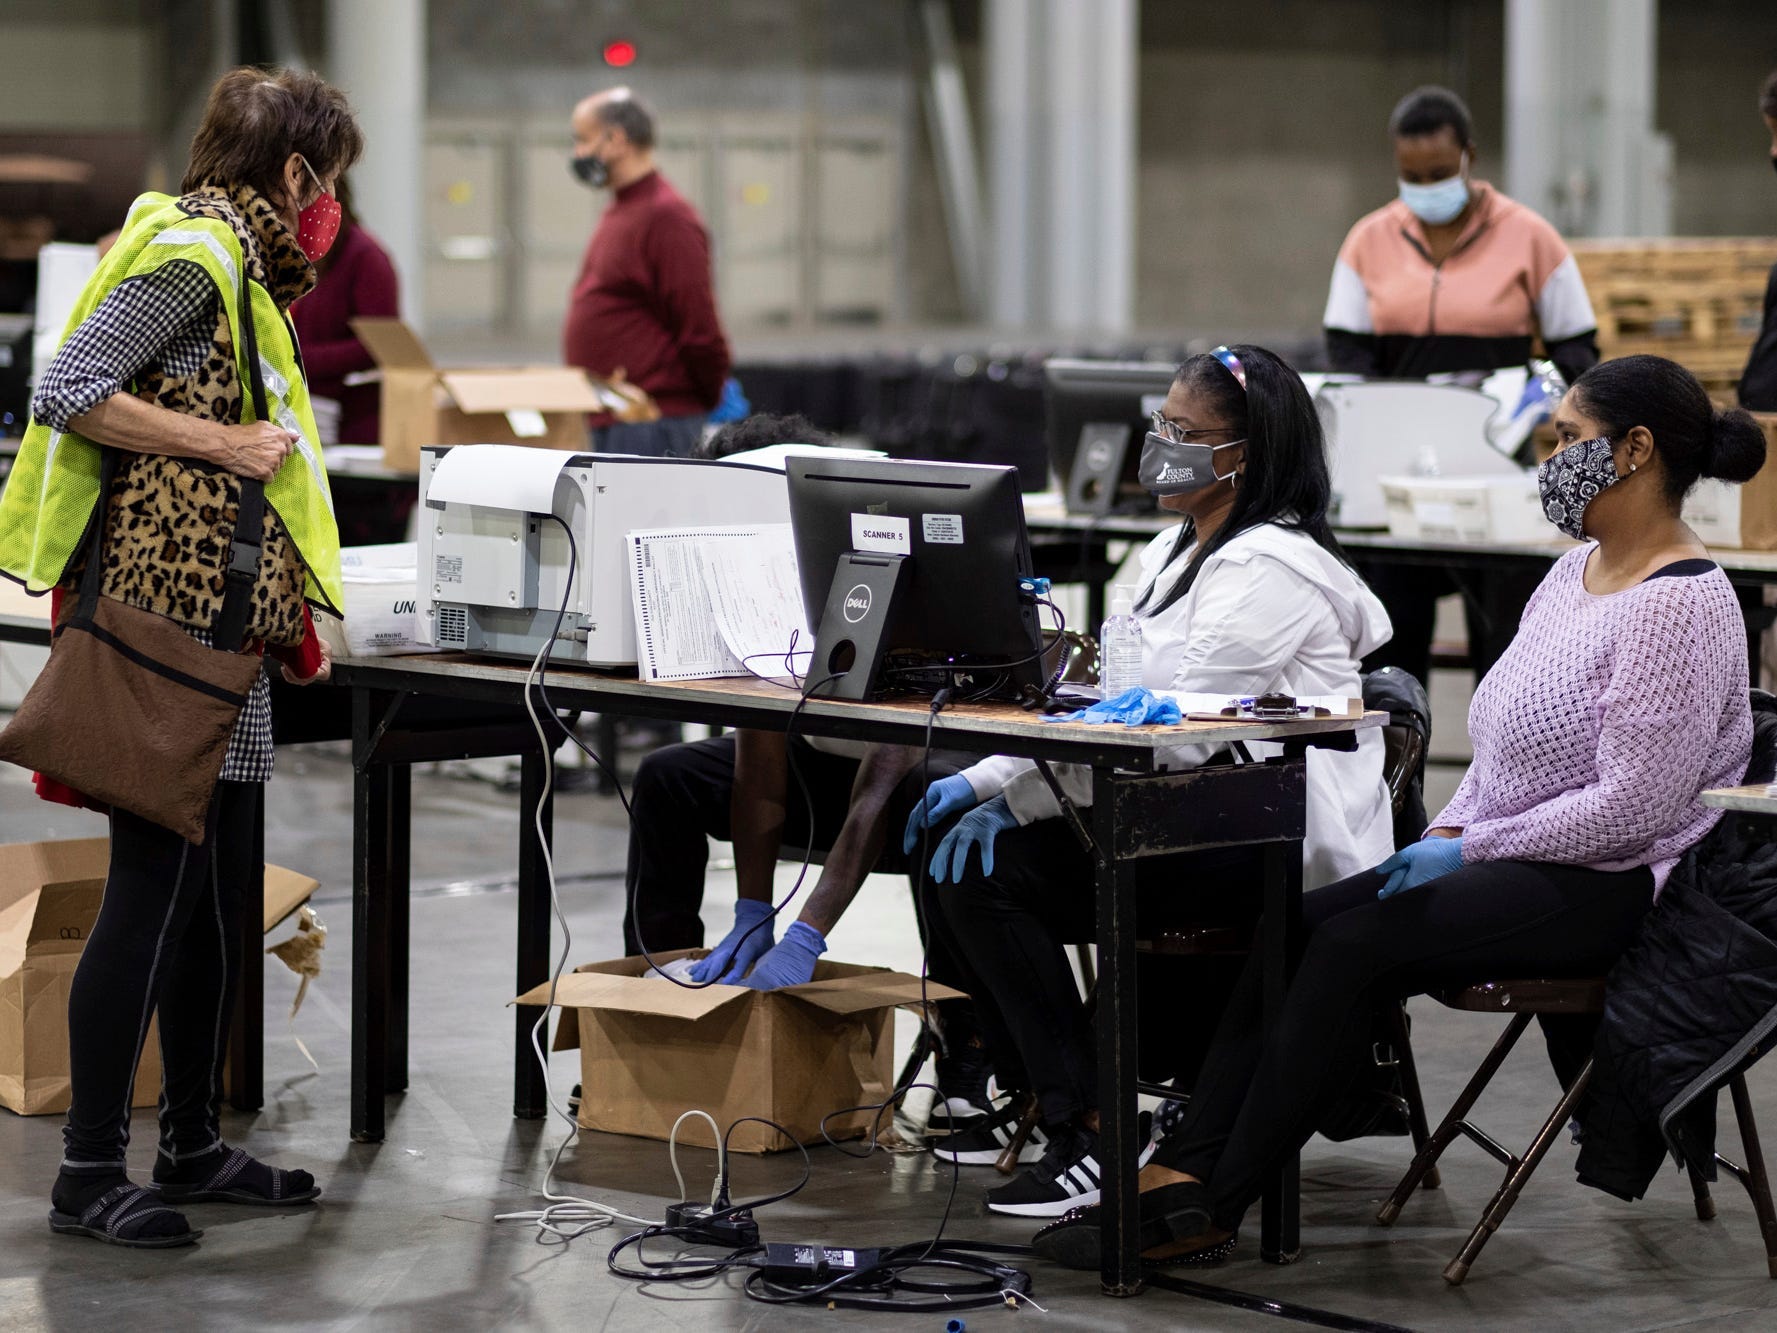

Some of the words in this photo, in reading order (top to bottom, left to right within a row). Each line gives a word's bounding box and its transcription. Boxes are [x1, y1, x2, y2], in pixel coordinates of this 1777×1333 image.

[1167, 467, 1193, 475] FULTON
[863, 529, 896, 540] SCANNER
[898, 532, 904, 541] 5
[846, 598, 868, 609] DELL
